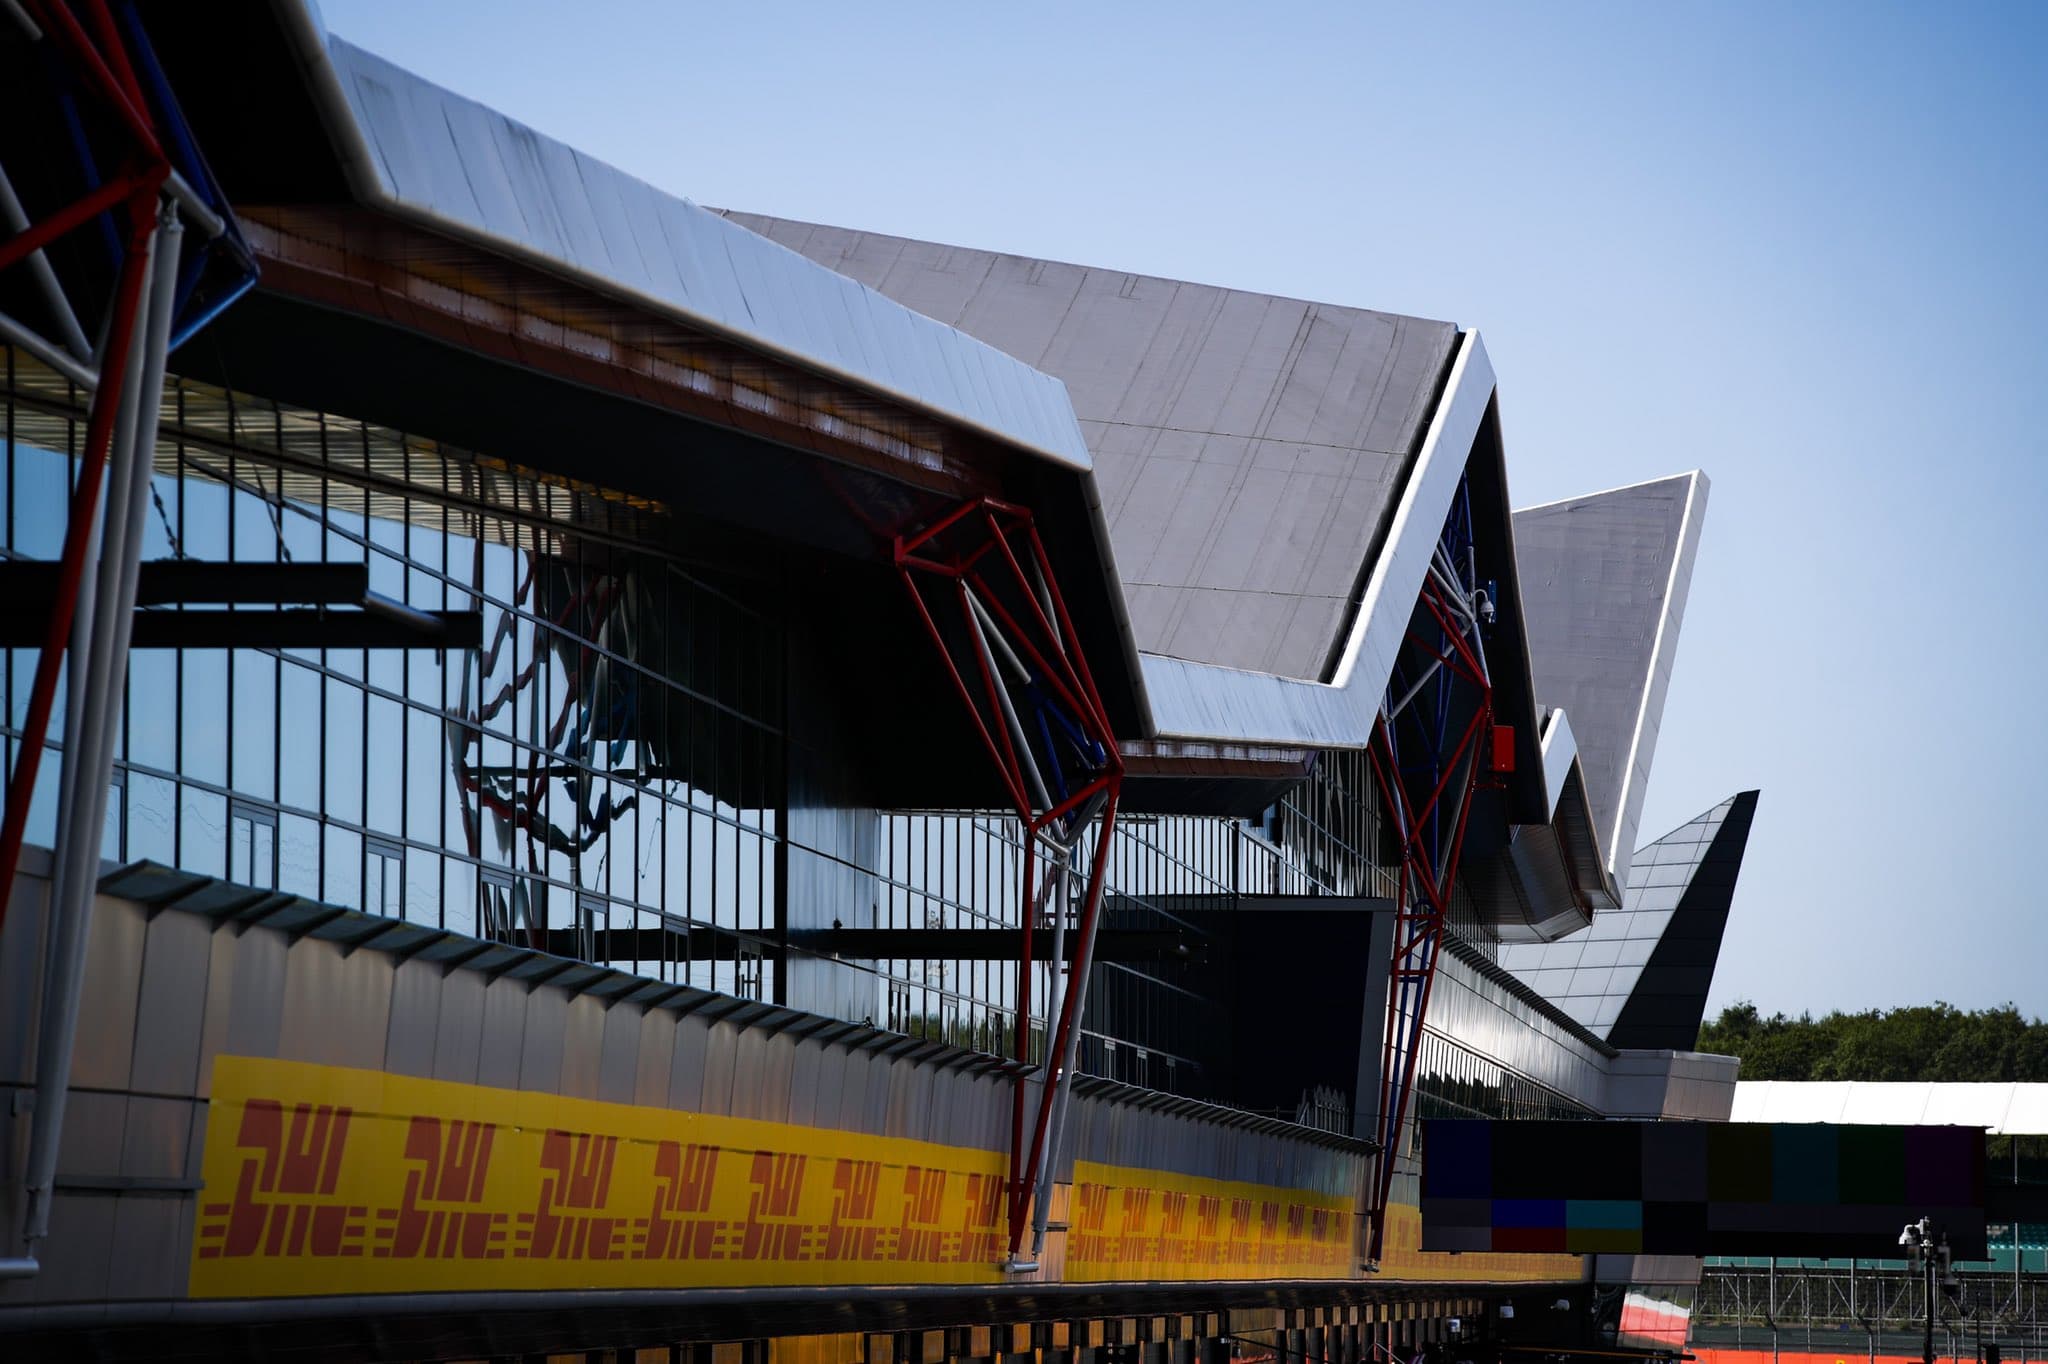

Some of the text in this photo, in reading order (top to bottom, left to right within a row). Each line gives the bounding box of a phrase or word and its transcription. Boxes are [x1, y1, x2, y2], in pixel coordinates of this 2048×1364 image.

[222, 1099, 1004, 1262] DHL DHL DHL DHL DHL DHL DHL DHL
[1075, 1184, 1108, 1262] DHL
